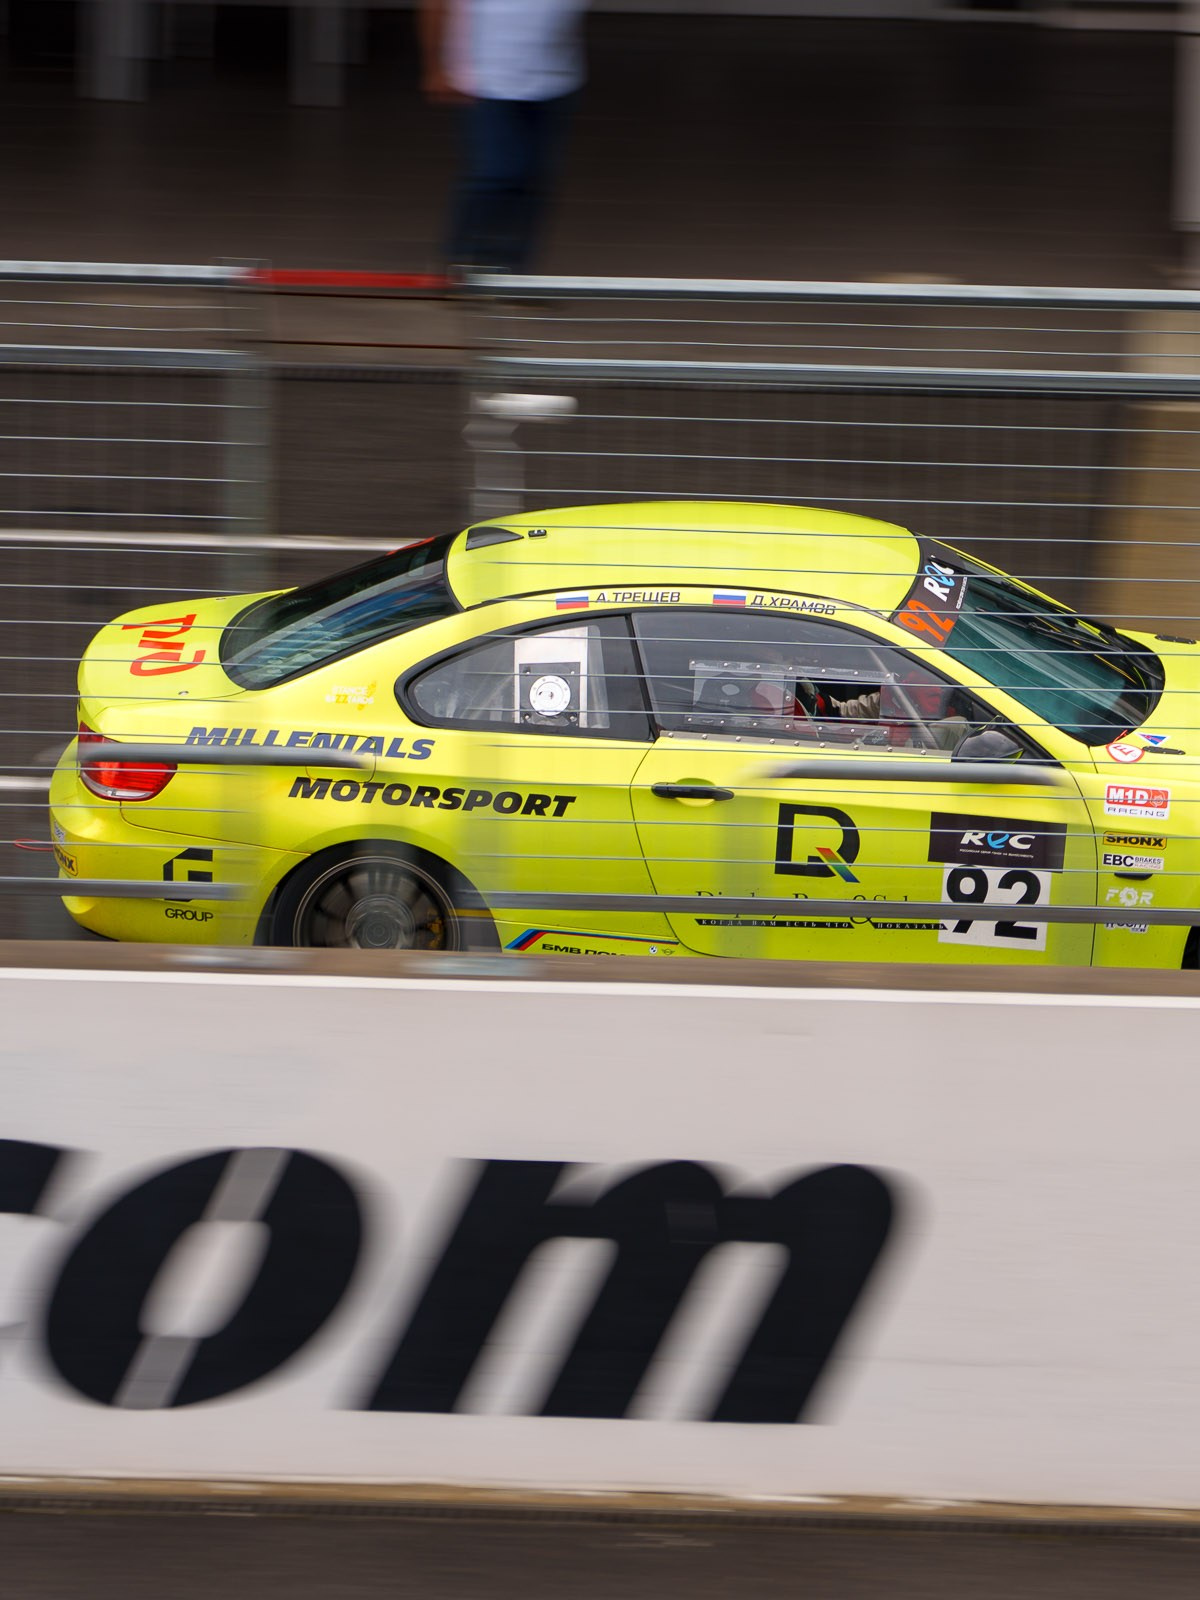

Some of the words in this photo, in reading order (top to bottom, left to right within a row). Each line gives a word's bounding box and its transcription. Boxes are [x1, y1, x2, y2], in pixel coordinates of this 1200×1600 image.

[750, 594, 836, 616] Д.ХРАМОВ
[898, 599, 956, 642] 92
[288, 776, 577, 818] MOTORSPORT
[1108, 787, 1149, 805] M1D
[1107, 806, 1165, 818] RACING
[1105, 833, 1164, 848] SHONX
[1103, 853, 1134, 867] EBC
[946, 864, 1042, 941] 92
[164, 907, 214, 922] GROUP
[701, 918, 743, 927] КОГДА
[751, 919, 777, 927] ВАМ
[785, 920, 817, 928] ЕСТЬ
[877, 922, 945, 930] ПОКАЗАТЬ
[0, 1138, 930, 1425] om
